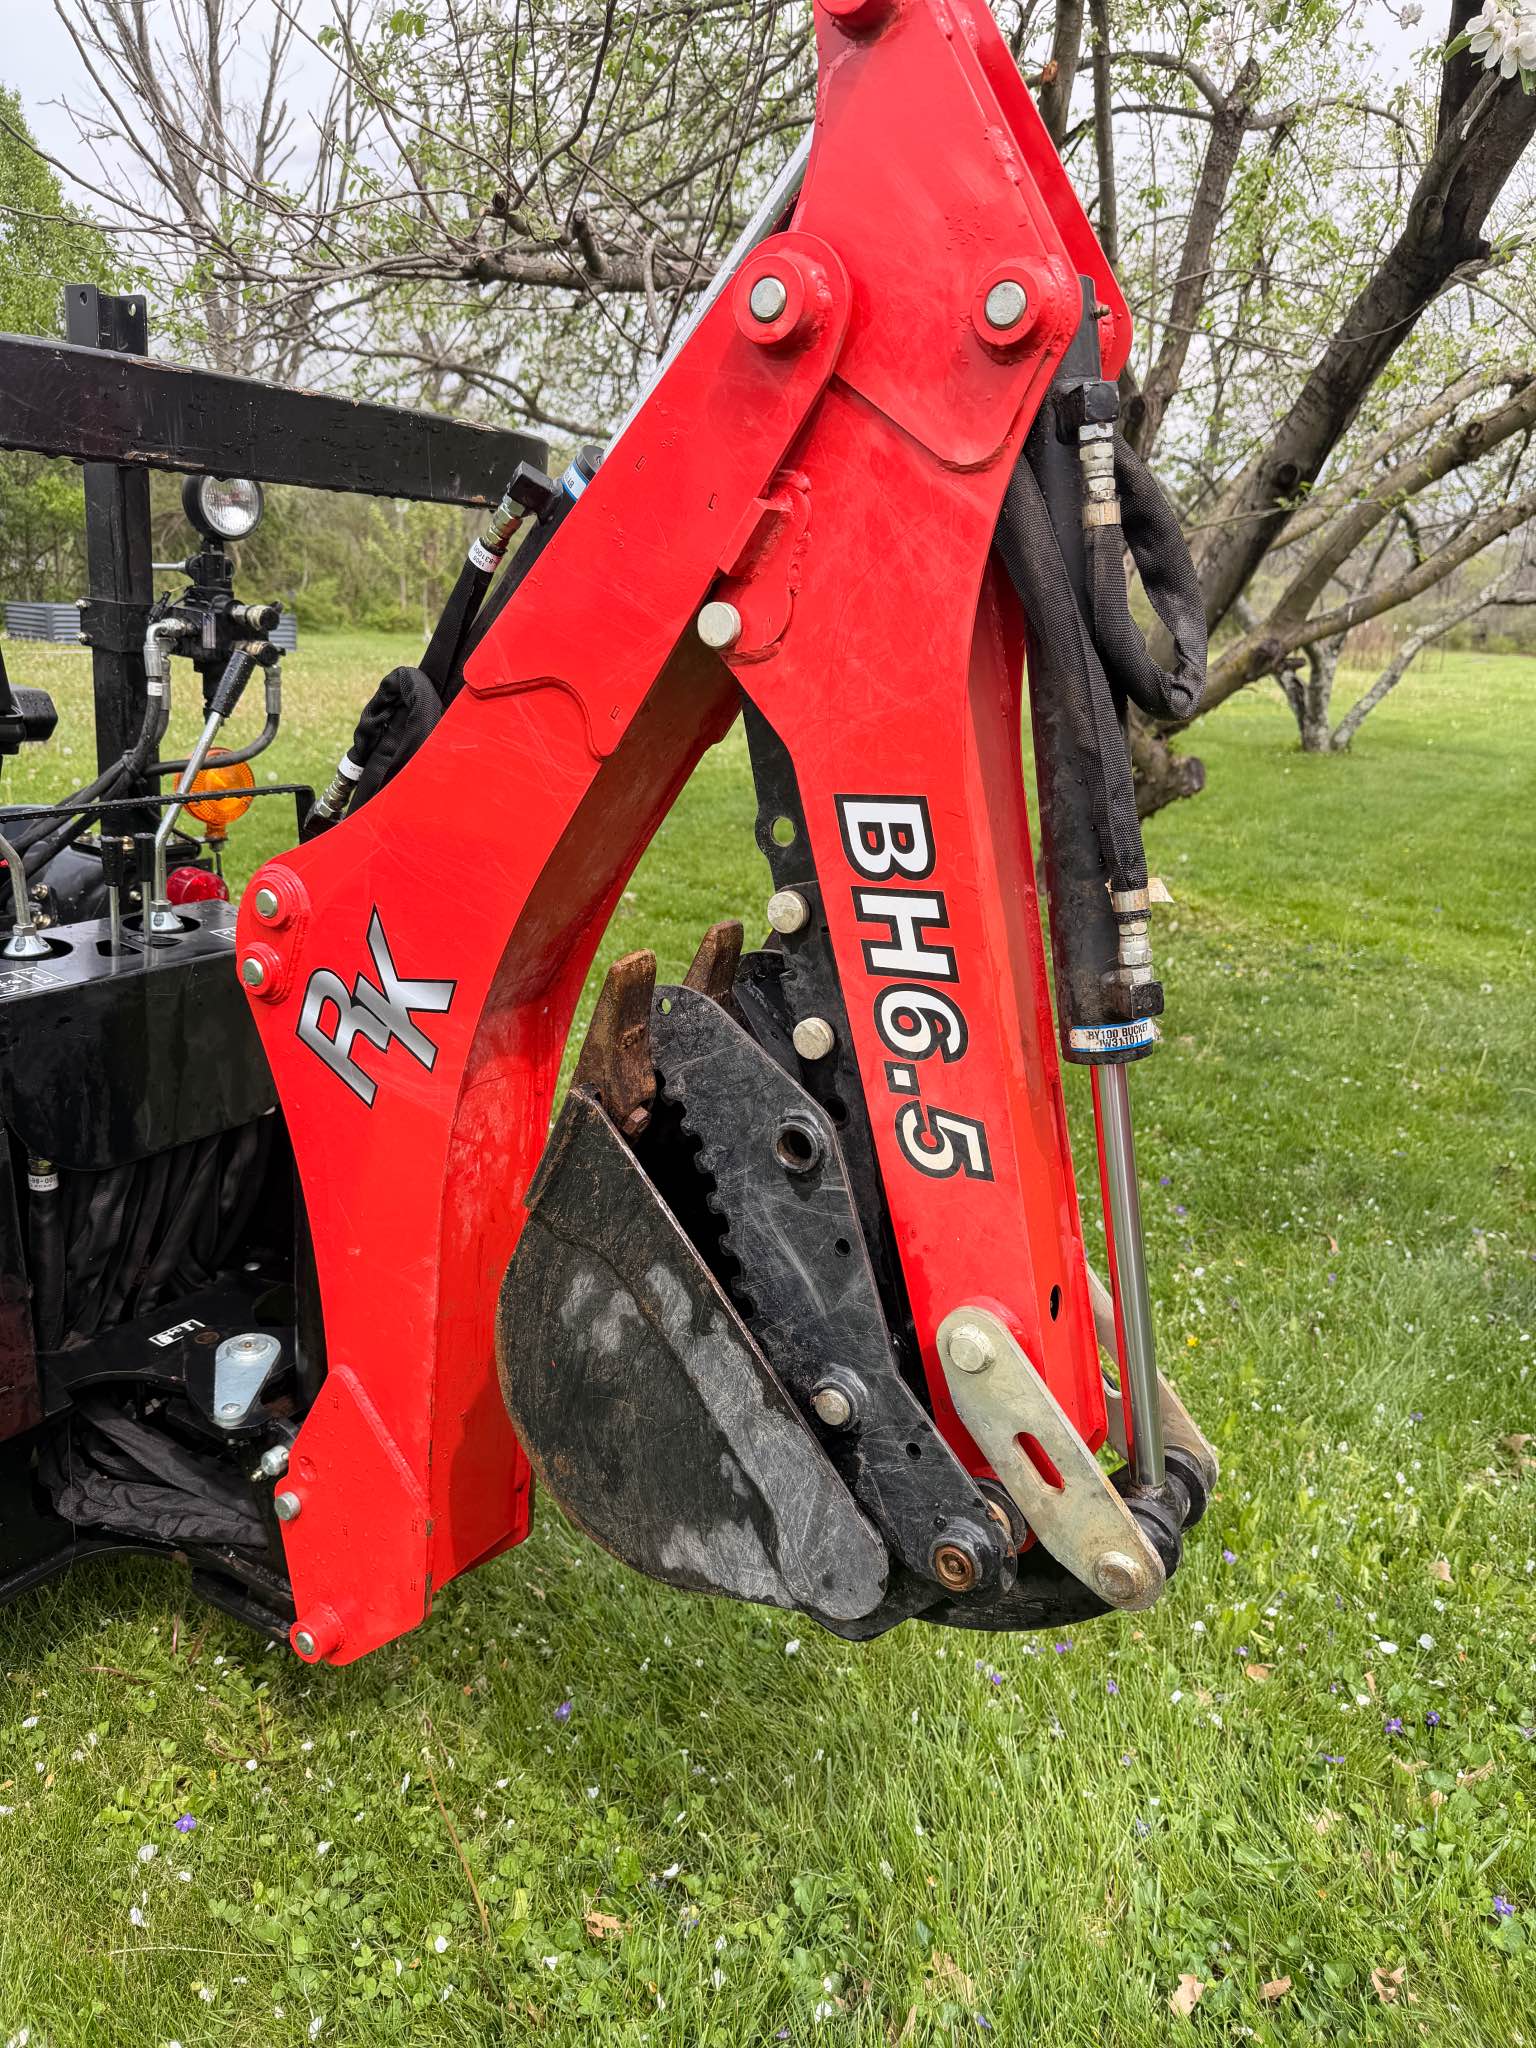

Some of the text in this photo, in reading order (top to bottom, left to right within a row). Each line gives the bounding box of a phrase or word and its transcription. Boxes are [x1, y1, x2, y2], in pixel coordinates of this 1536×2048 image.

[295, 902, 458, 1110] RK
[833, 794, 996, 1183] BH6.5
[1121, 1022, 1149, 1037] BUCKET
